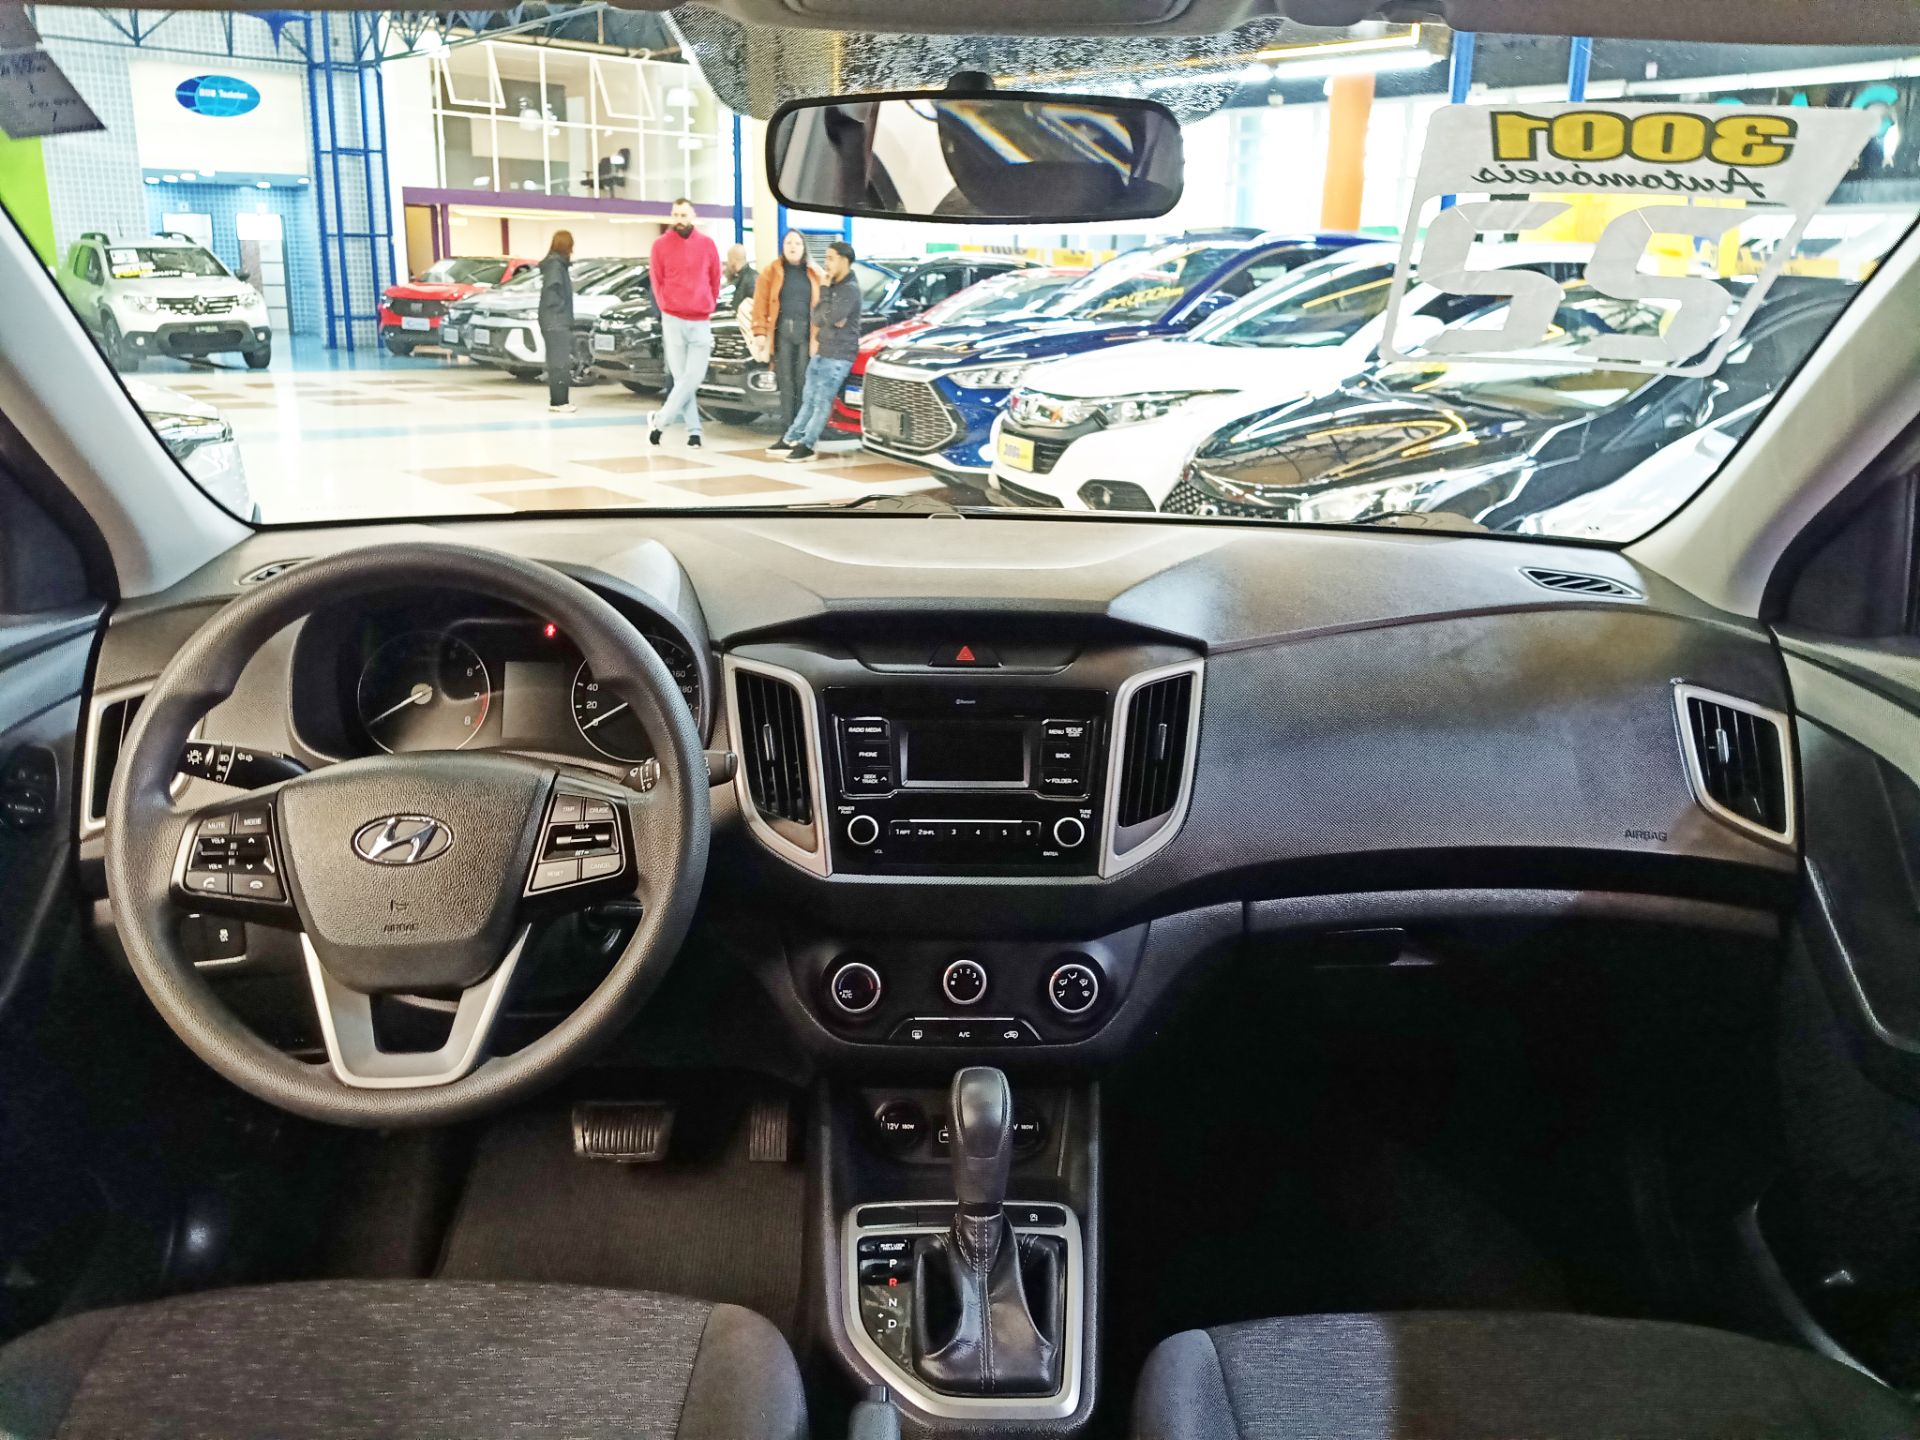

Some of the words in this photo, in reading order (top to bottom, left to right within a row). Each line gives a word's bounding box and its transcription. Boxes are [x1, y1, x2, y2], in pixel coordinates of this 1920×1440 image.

[467, 668, 473, 677] 6
[474, 692, 480, 700] 7
[586, 702, 598, 710] 20
[464, 716, 471, 725] 8
[207, 822, 226, 830] MUTE
[243, 817, 262, 826] MODE
[1624, 829, 1668, 842] AIRBAG
[886, 1122, 900, 1130] 12V
[889, 1258, 898, 1268] P
[888, 1277, 898, 1287] R
[888, 1298, 898, 1307] N
[888, 1319, 897, 1328] D
